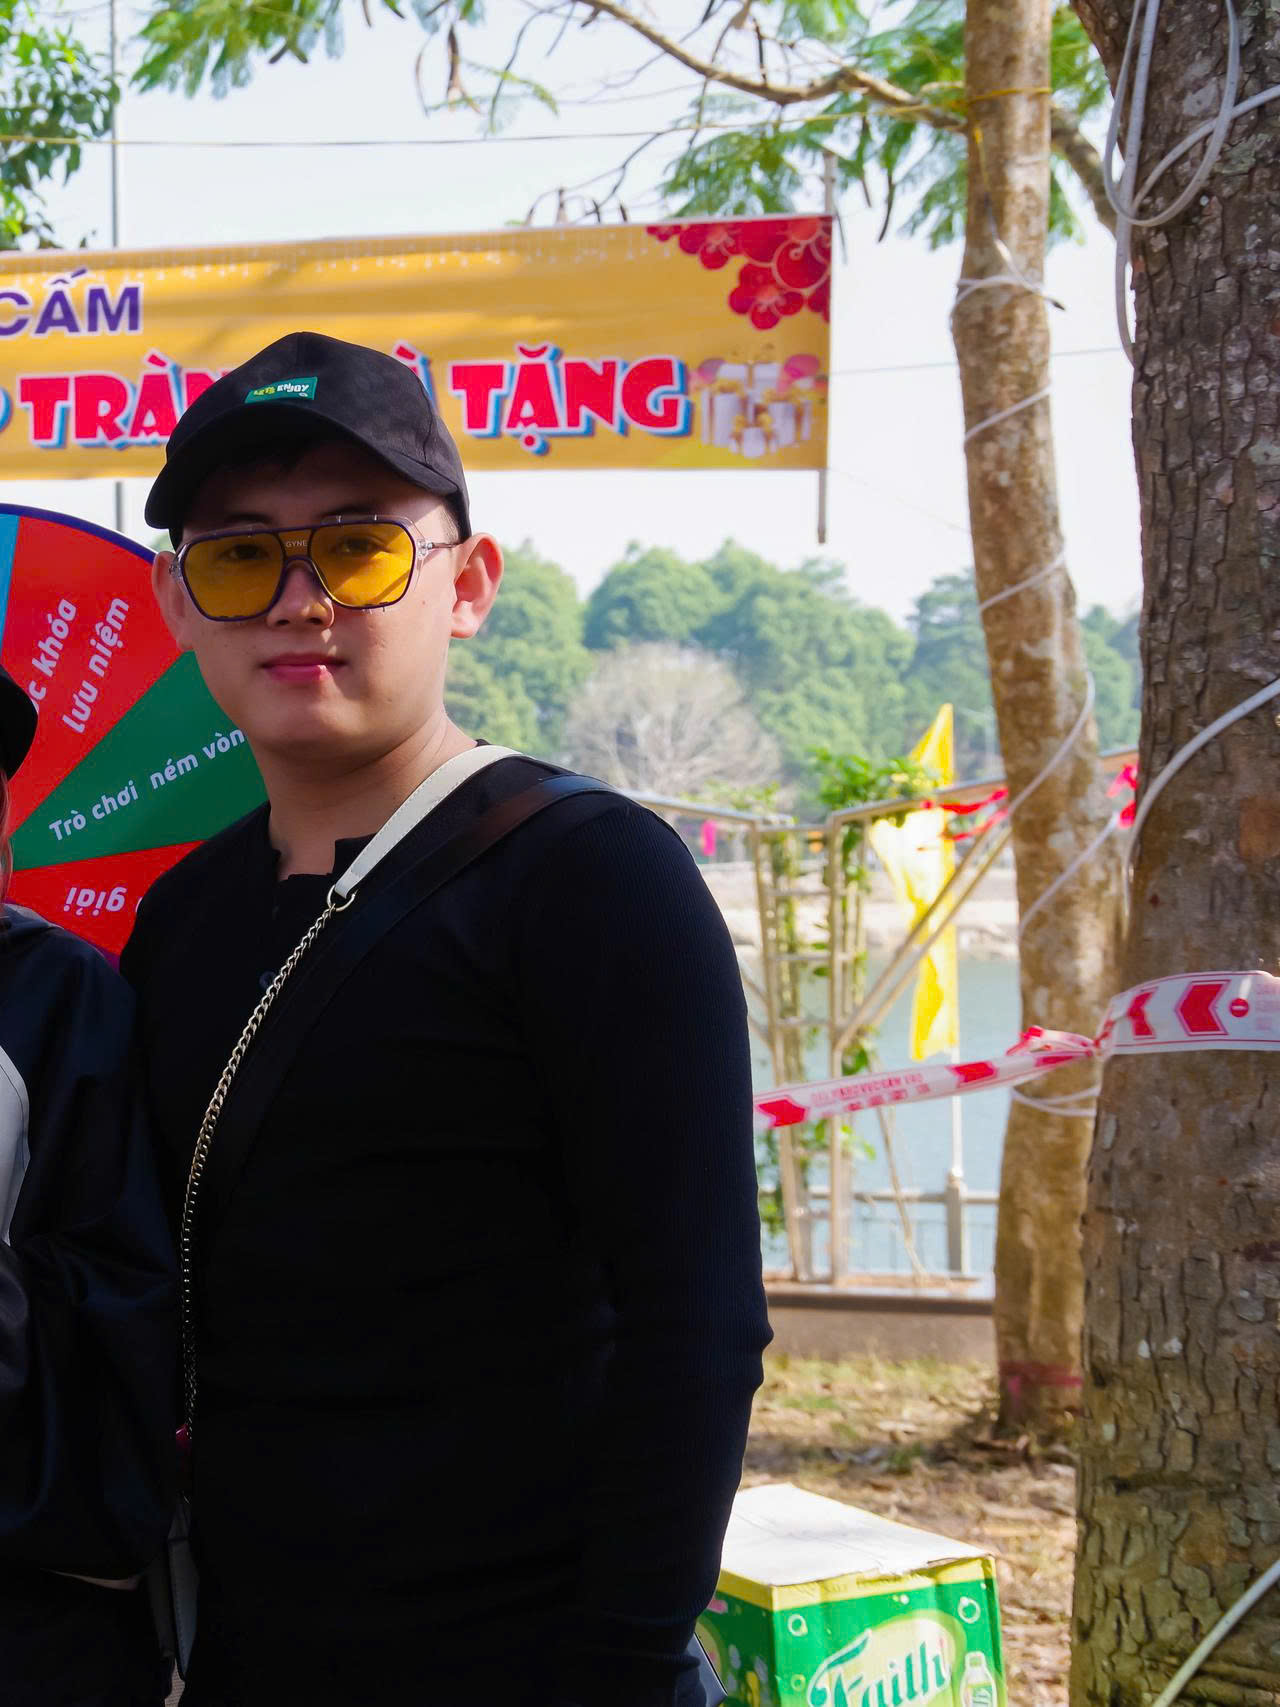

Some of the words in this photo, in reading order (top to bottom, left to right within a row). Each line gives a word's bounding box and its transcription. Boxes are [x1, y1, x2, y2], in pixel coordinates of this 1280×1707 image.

[451, 343, 686, 453] TẶNG
[32, 599, 77, 677] khóa
[62, 680, 99, 733] lưu
[88, 598, 129, 677] niệm
[49, 810, 87, 840] Trò
[92, 780, 139, 820] chơi
[150, 753, 199, 789] ném
[202, 730, 248, 759] vòn
